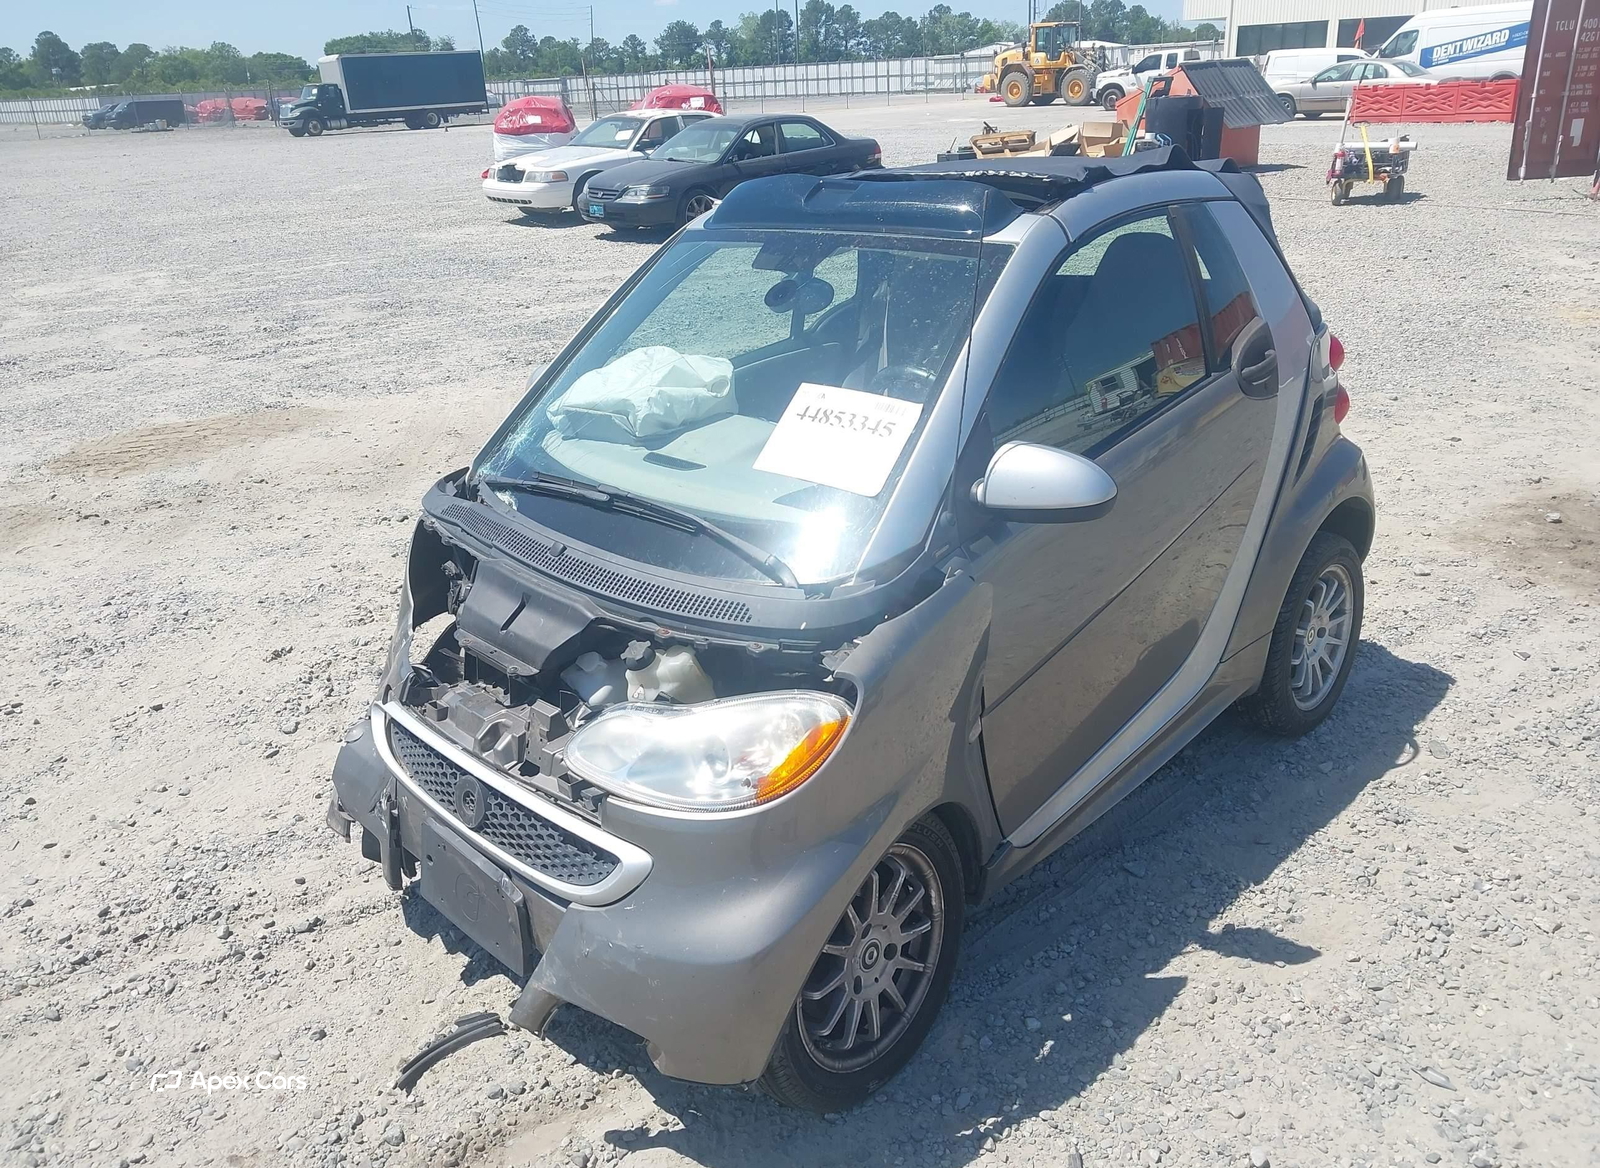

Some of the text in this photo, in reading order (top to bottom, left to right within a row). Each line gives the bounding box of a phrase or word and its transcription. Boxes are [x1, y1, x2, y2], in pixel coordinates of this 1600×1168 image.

[1555, 20, 1576, 31] TCLU
[1432, 41, 1463, 59] DENT
[1462, 29, 1510, 52] WIZARD
[796, 405, 897, 438] 44853345
